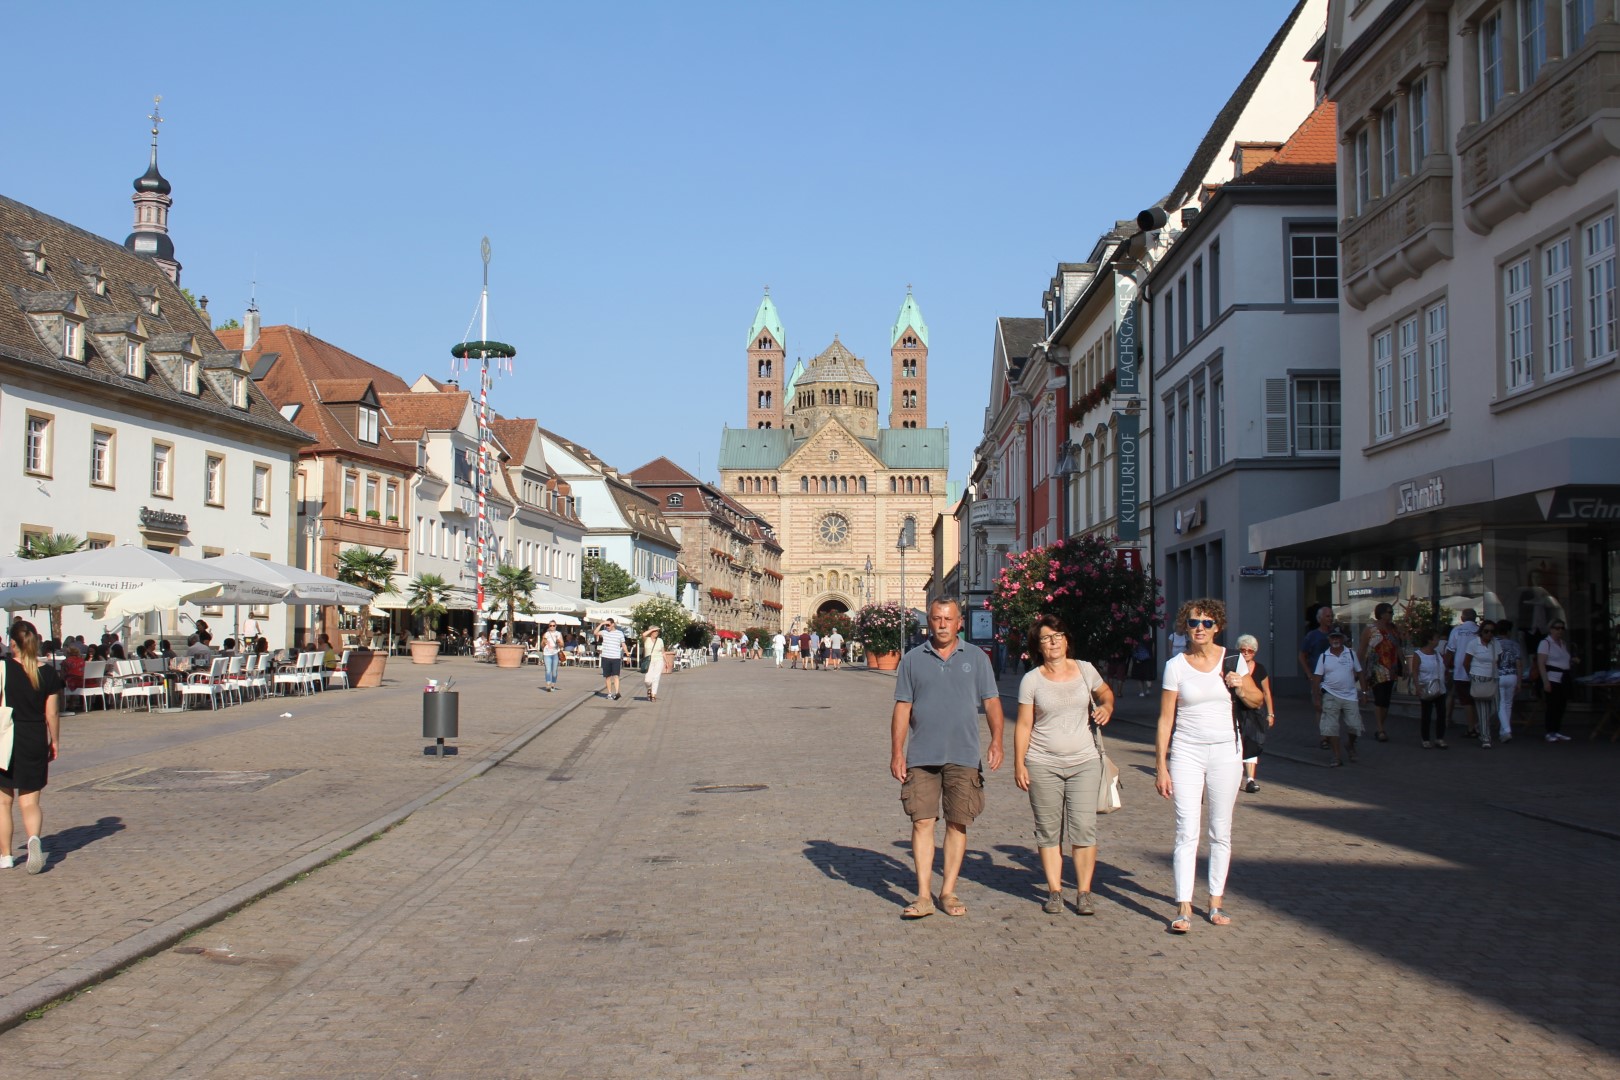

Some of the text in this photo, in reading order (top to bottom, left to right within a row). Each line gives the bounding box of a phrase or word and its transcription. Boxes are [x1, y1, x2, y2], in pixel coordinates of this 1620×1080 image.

[1120, 293, 1133, 388] FLACHSGASSE
[1121, 433, 1135, 523] KULTURHOF
[1397, 476, 1444, 515] Schmitt
[1270, 555, 1334, 569] Schmitt
[0, 579, 18, 588] eria
